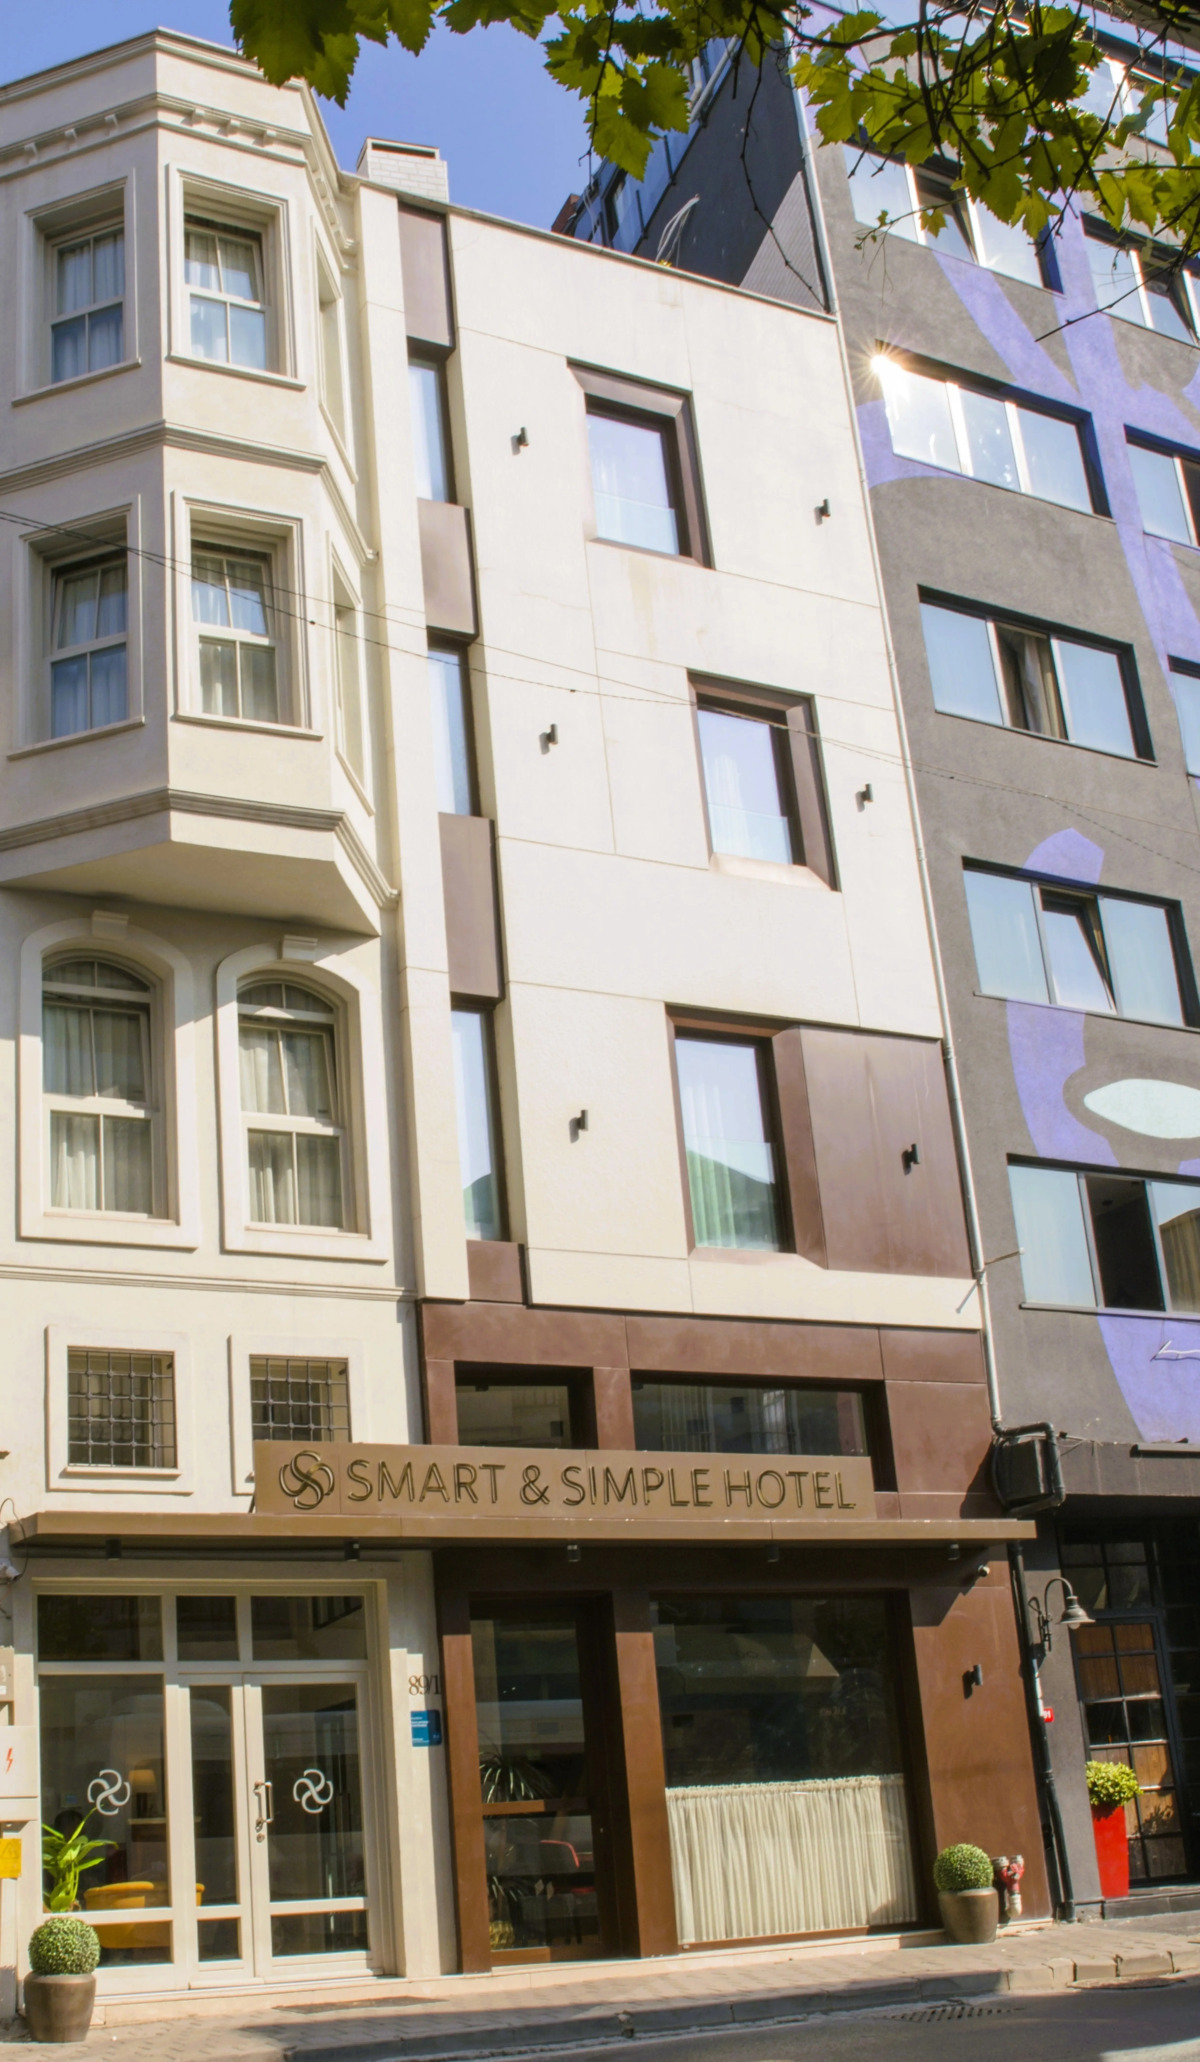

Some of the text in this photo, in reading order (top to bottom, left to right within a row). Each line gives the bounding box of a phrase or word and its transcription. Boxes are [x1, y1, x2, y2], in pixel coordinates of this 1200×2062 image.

[347, 1459, 857, 1509] SMART & SIMPLE HOTEL
[408, 1674, 440, 1695] 89/1
